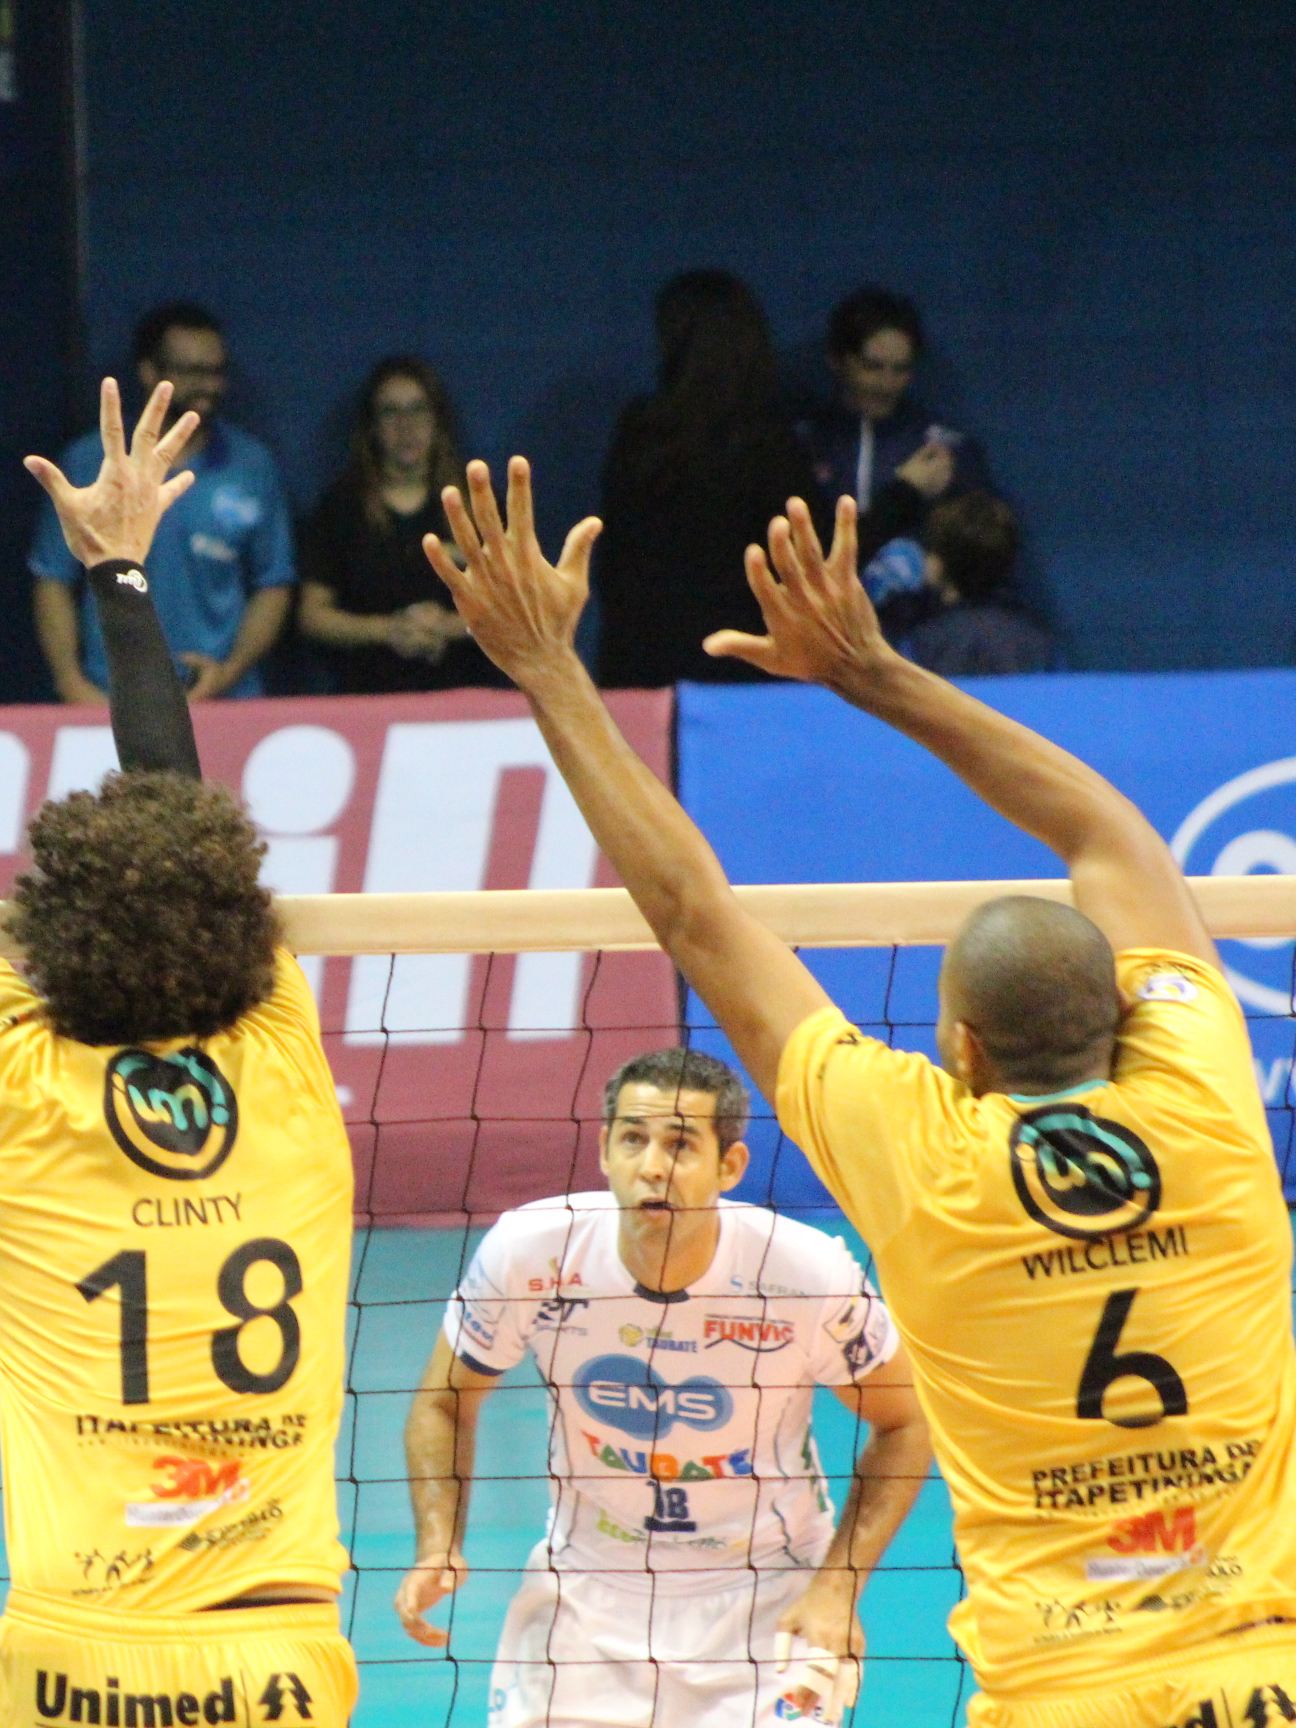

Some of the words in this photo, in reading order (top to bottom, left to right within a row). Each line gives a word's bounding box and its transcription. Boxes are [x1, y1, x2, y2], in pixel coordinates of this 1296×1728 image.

[132, 1193, 242, 1228] CLINTY
[1021, 1225, 1190, 1280] WILCLEMI
[75, 1237, 304, 1407] 18
[705, 1319, 795, 1342] FUNVIC
[1076, 1286, 1189, 1429] 6
[589, 1380, 717, 1420] EMS
[150, 1455, 243, 1499] 3M
[1032, 1446, 1217, 1490] PREFEITURA
[1106, 1505, 1198, 1554] 3M
[35, 1668, 237, 1728] Unimed
